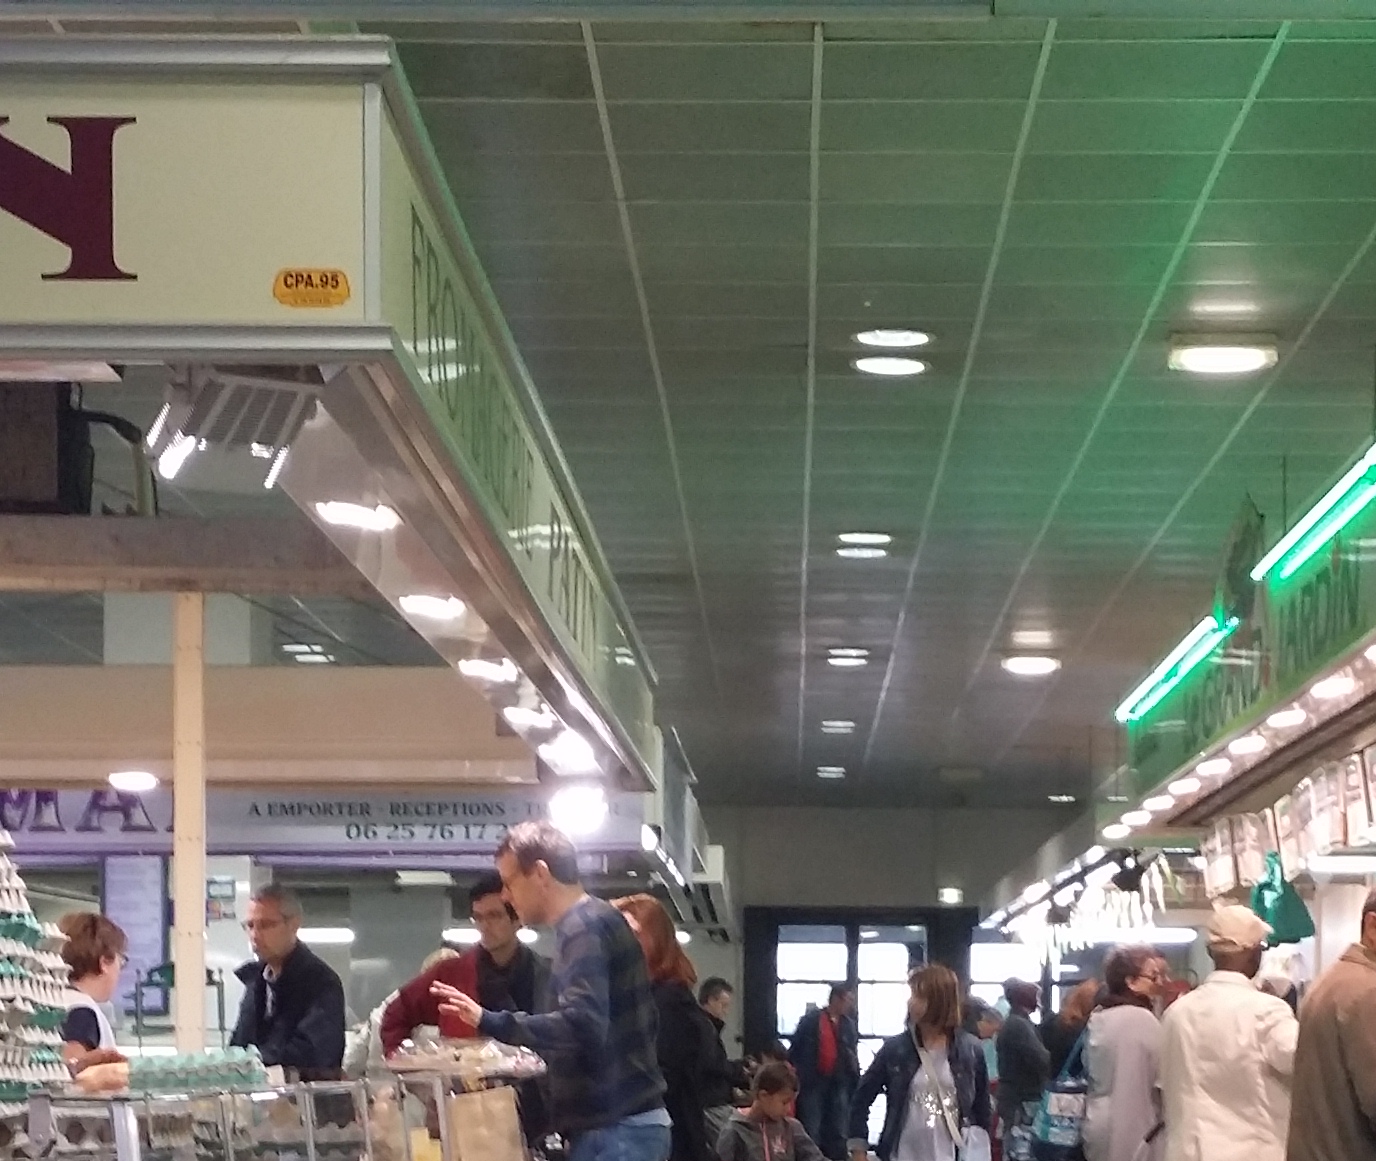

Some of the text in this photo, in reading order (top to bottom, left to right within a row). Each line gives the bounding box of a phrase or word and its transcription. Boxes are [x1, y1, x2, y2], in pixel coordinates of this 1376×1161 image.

[283, 272, 340, 290] CPA.95
[248, 802, 261, 817] A
[267, 802, 372, 817] EMPORTER
[388, 802, 506, 817] RECEPTIONS
[345, 823, 378, 840] 06
[386, 823, 416, 840] 25
[424, 823, 454, 840] 76
[463, 823, 487, 840] 17
